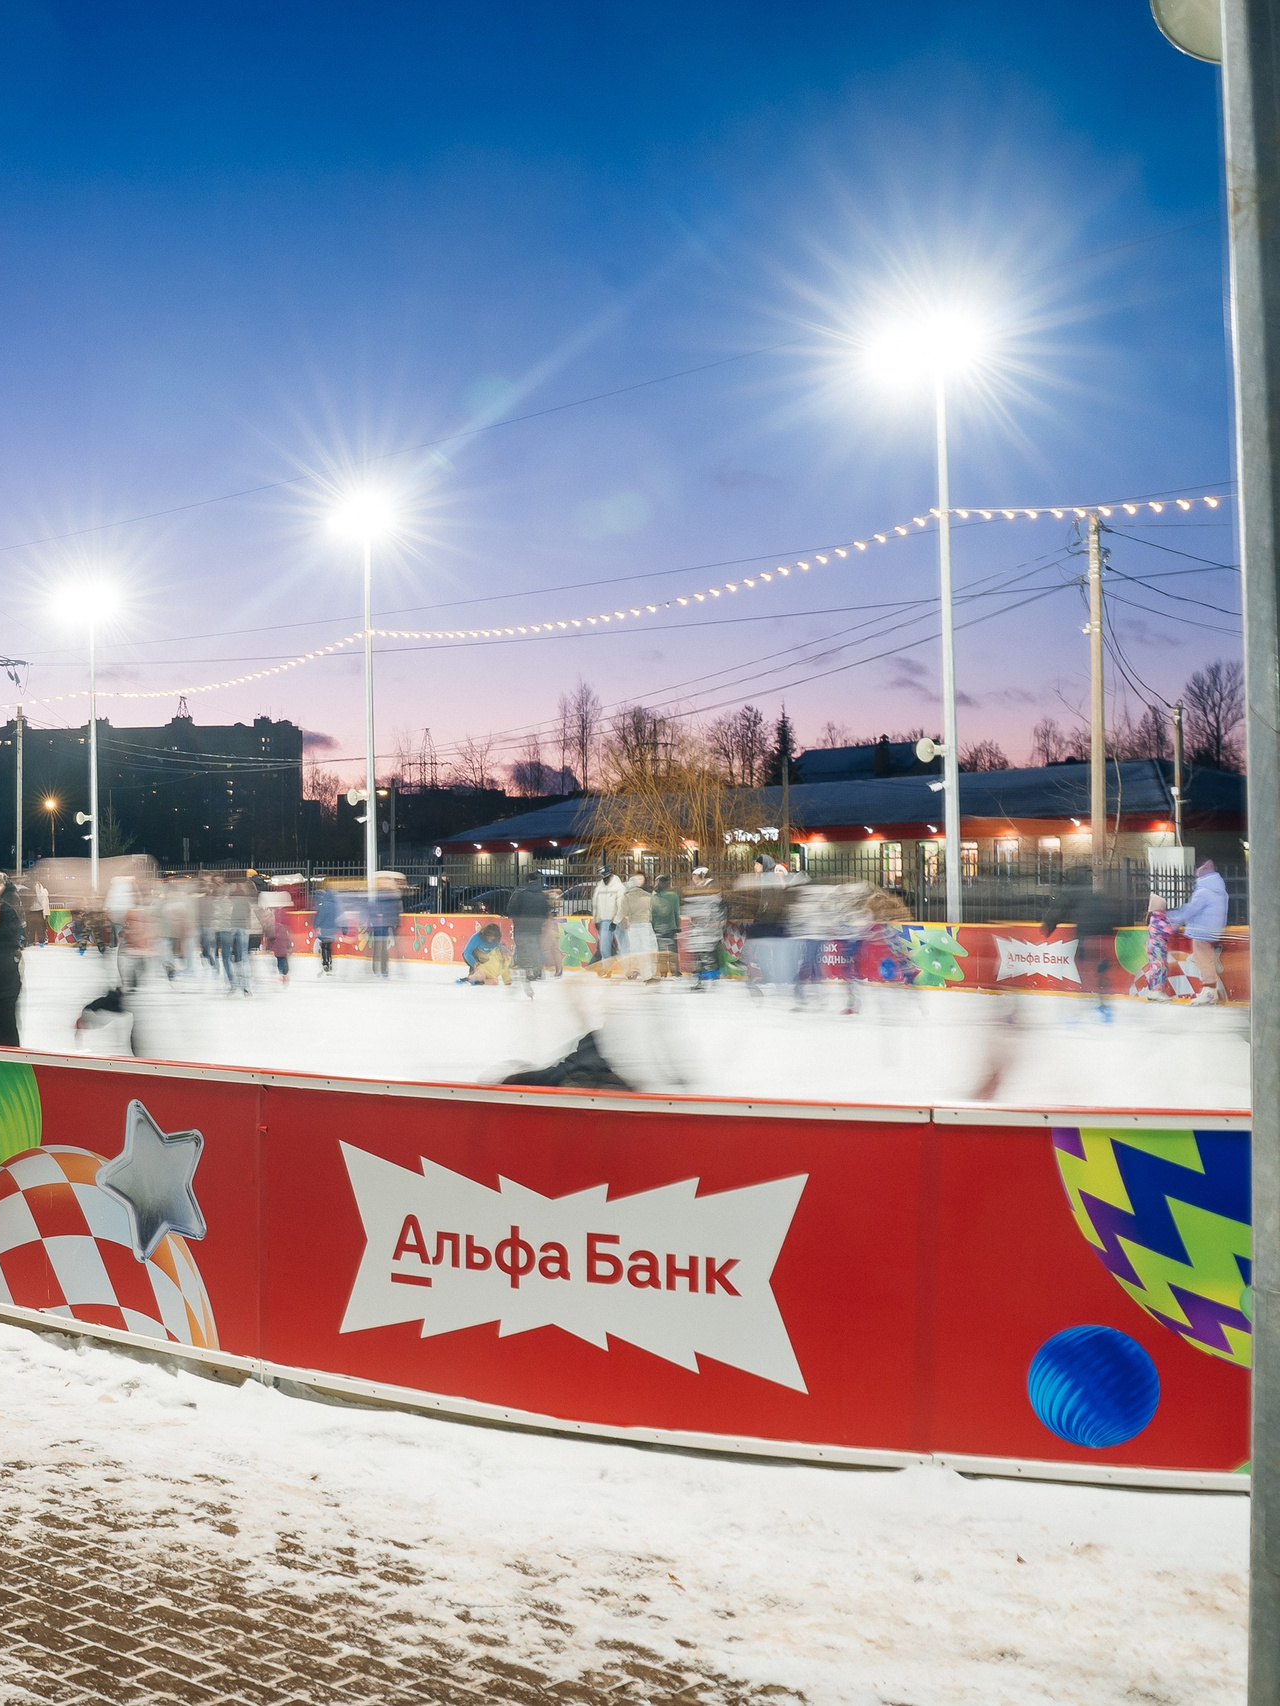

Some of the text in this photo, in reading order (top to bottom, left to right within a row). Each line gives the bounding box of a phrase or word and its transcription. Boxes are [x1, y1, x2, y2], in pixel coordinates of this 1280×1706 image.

[1008, 951, 1070, 966] Альфа Банк
[391, 1213, 743, 1297] Альфа Банк
